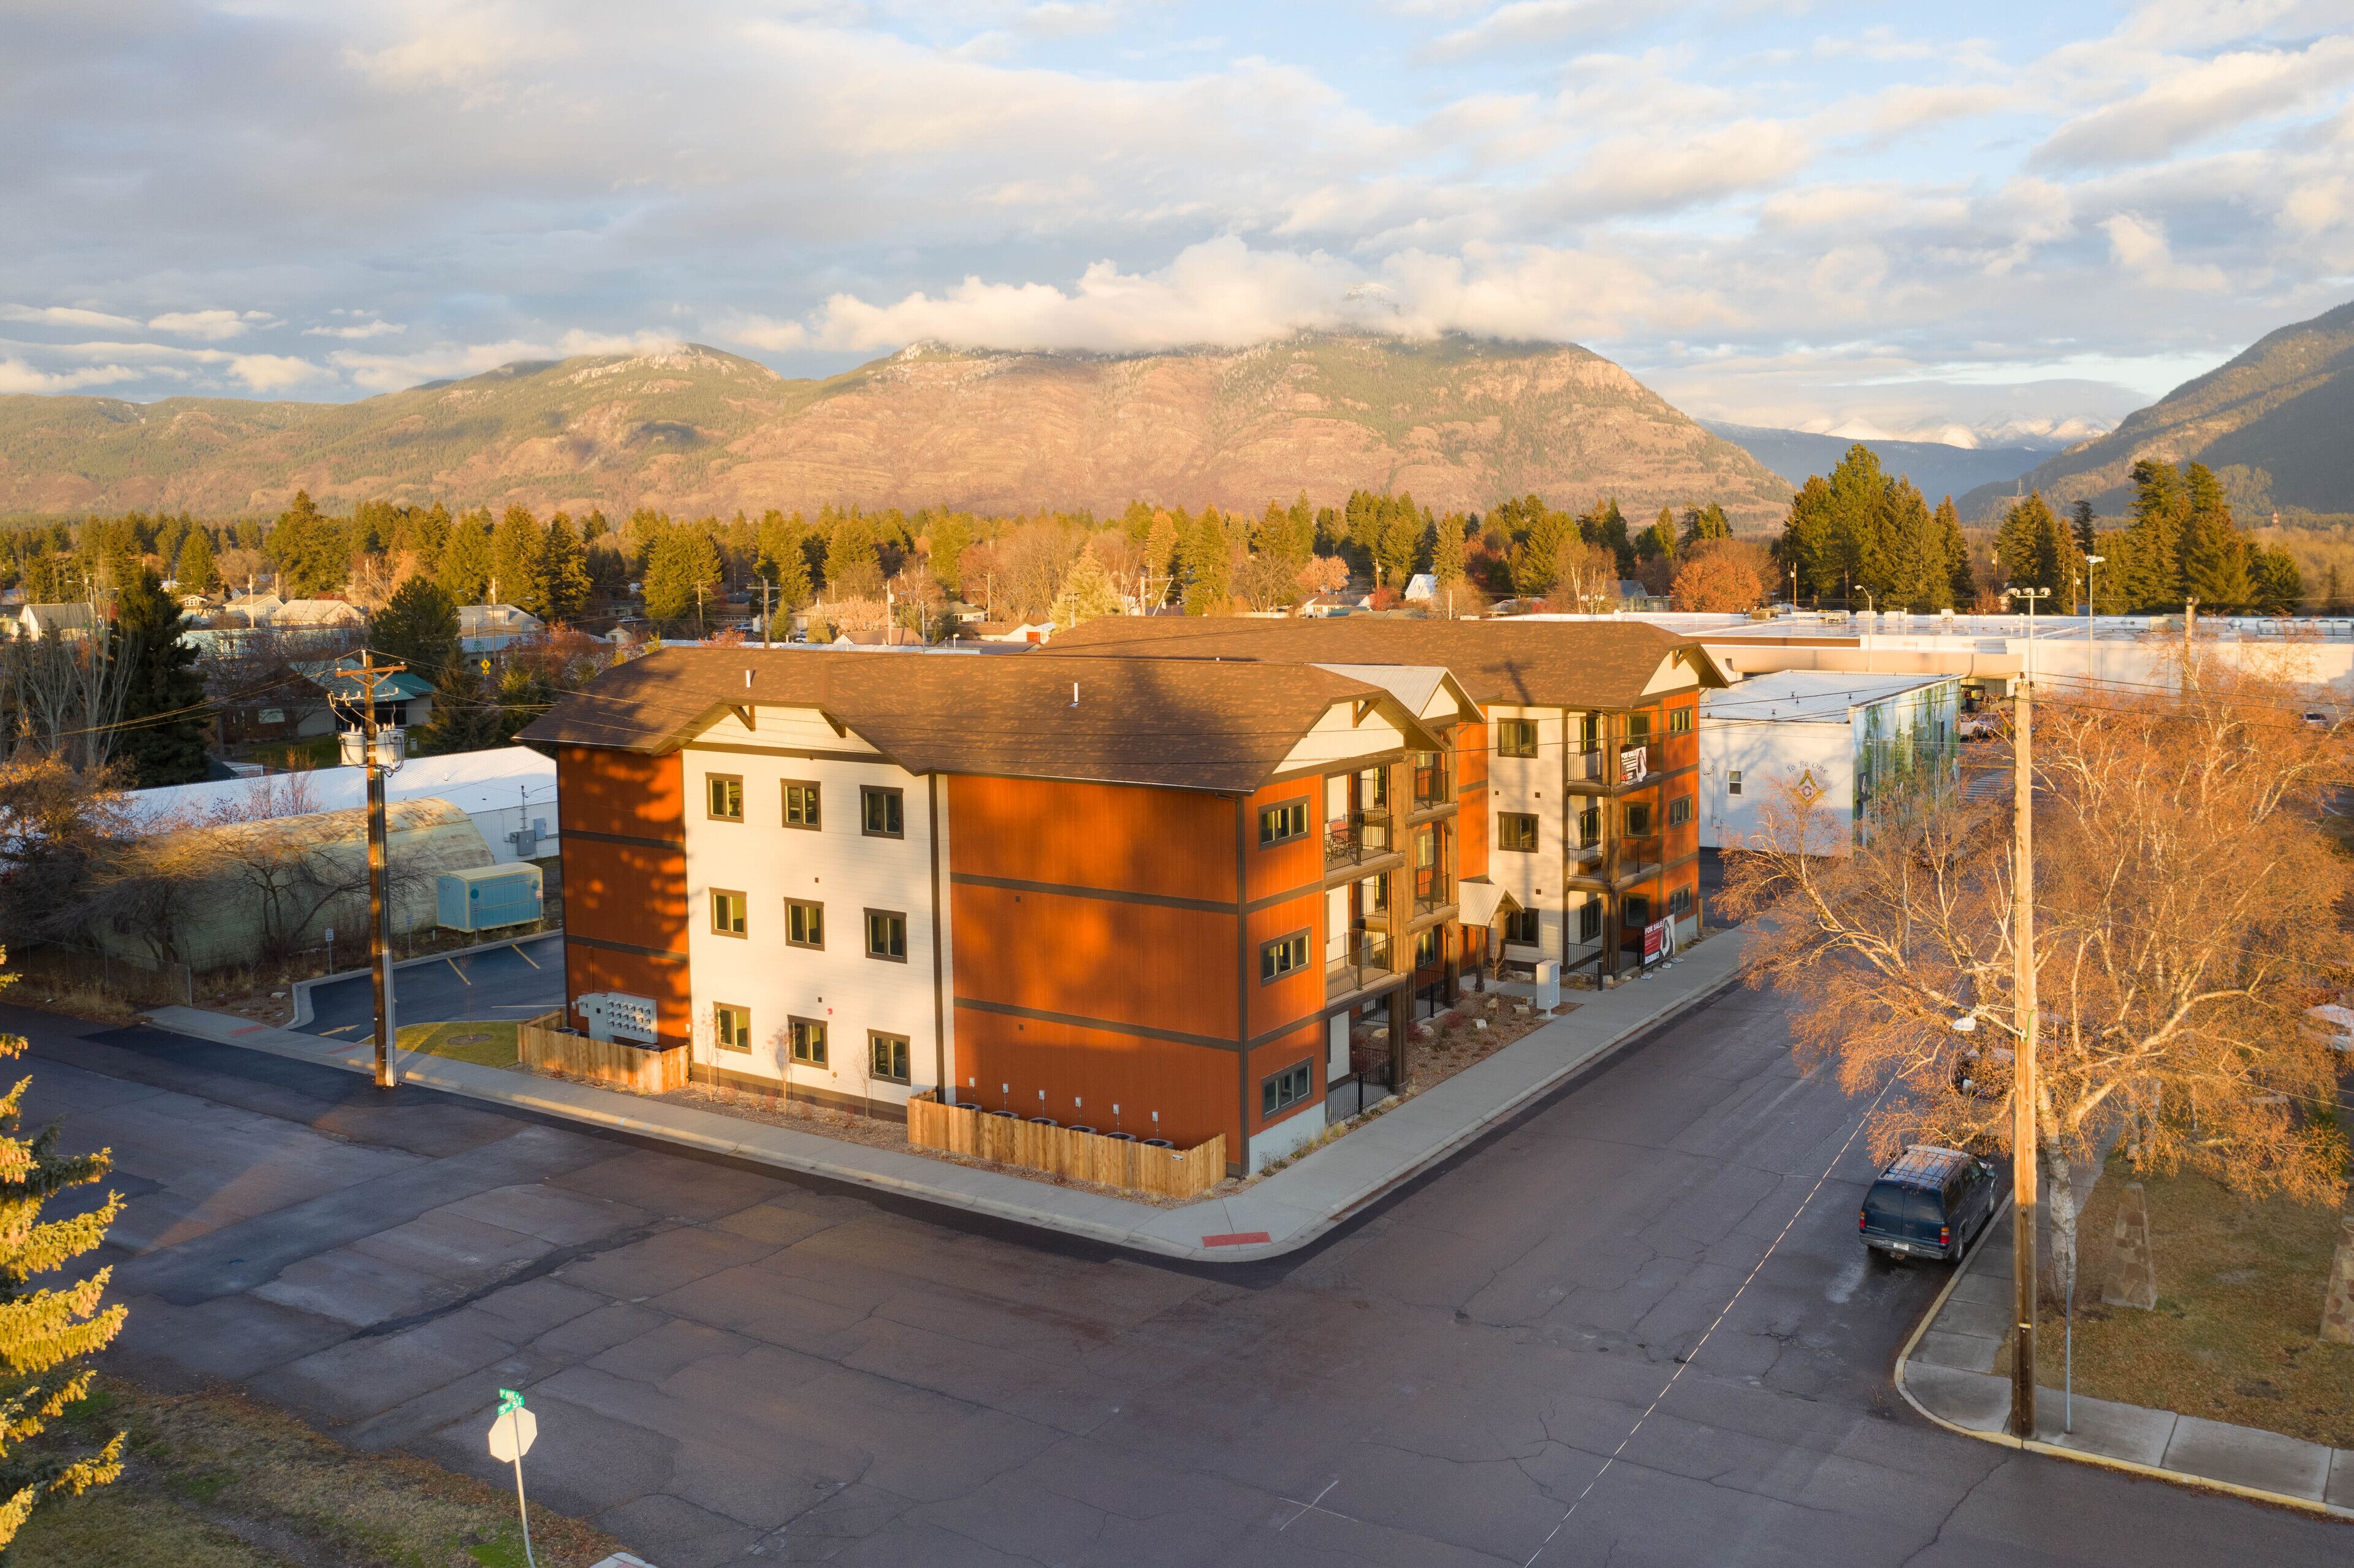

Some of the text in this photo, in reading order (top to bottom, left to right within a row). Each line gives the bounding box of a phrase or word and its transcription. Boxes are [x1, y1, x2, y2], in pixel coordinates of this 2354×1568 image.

[1786, 764, 1796, 773] To
[1811, 761, 1829, 775] One
[1802, 785, 1812, 797] G
[1645, 921, 1663, 935] FOR SALE
[500, 1402, 510, 1414] 5TH
